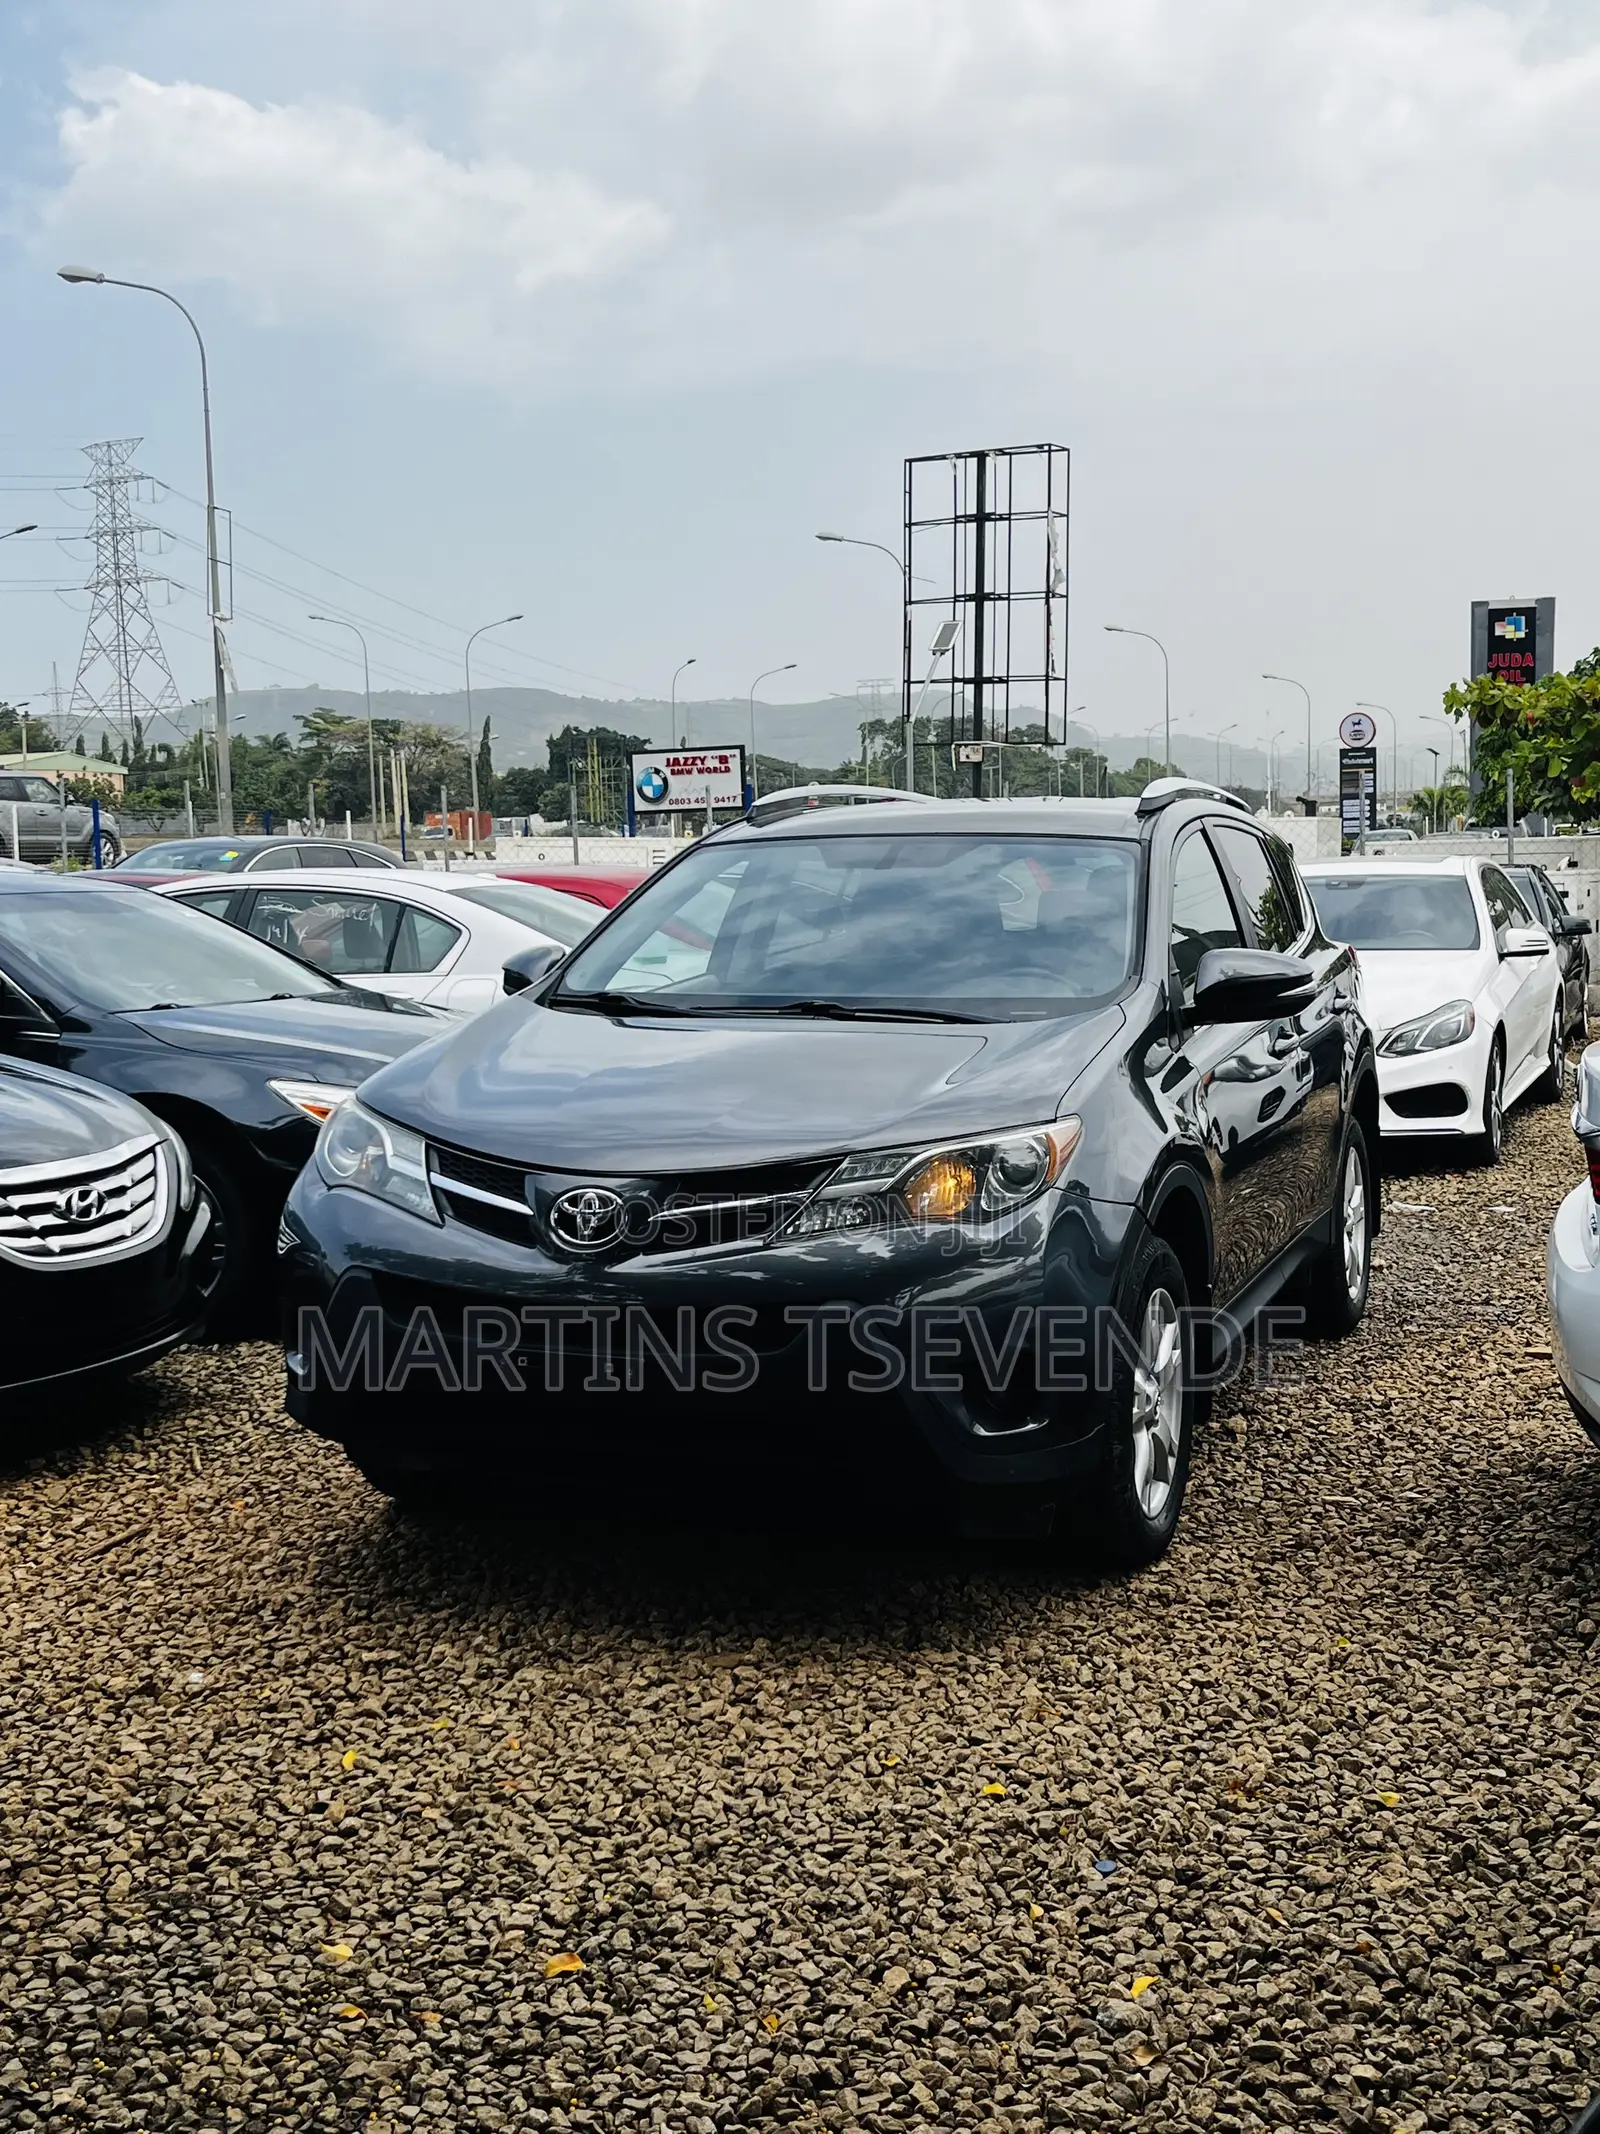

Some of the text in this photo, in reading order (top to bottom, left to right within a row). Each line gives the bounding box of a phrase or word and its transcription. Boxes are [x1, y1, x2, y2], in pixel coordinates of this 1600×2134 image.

[1488, 653, 1534, 668] JUDA
[1497, 670, 1526, 682] OIL
[665, 756, 707, 767] JAZZY
[670, 766, 731, 776] BMW WORLD
[668, 796, 737, 806] 0803 45 9417
